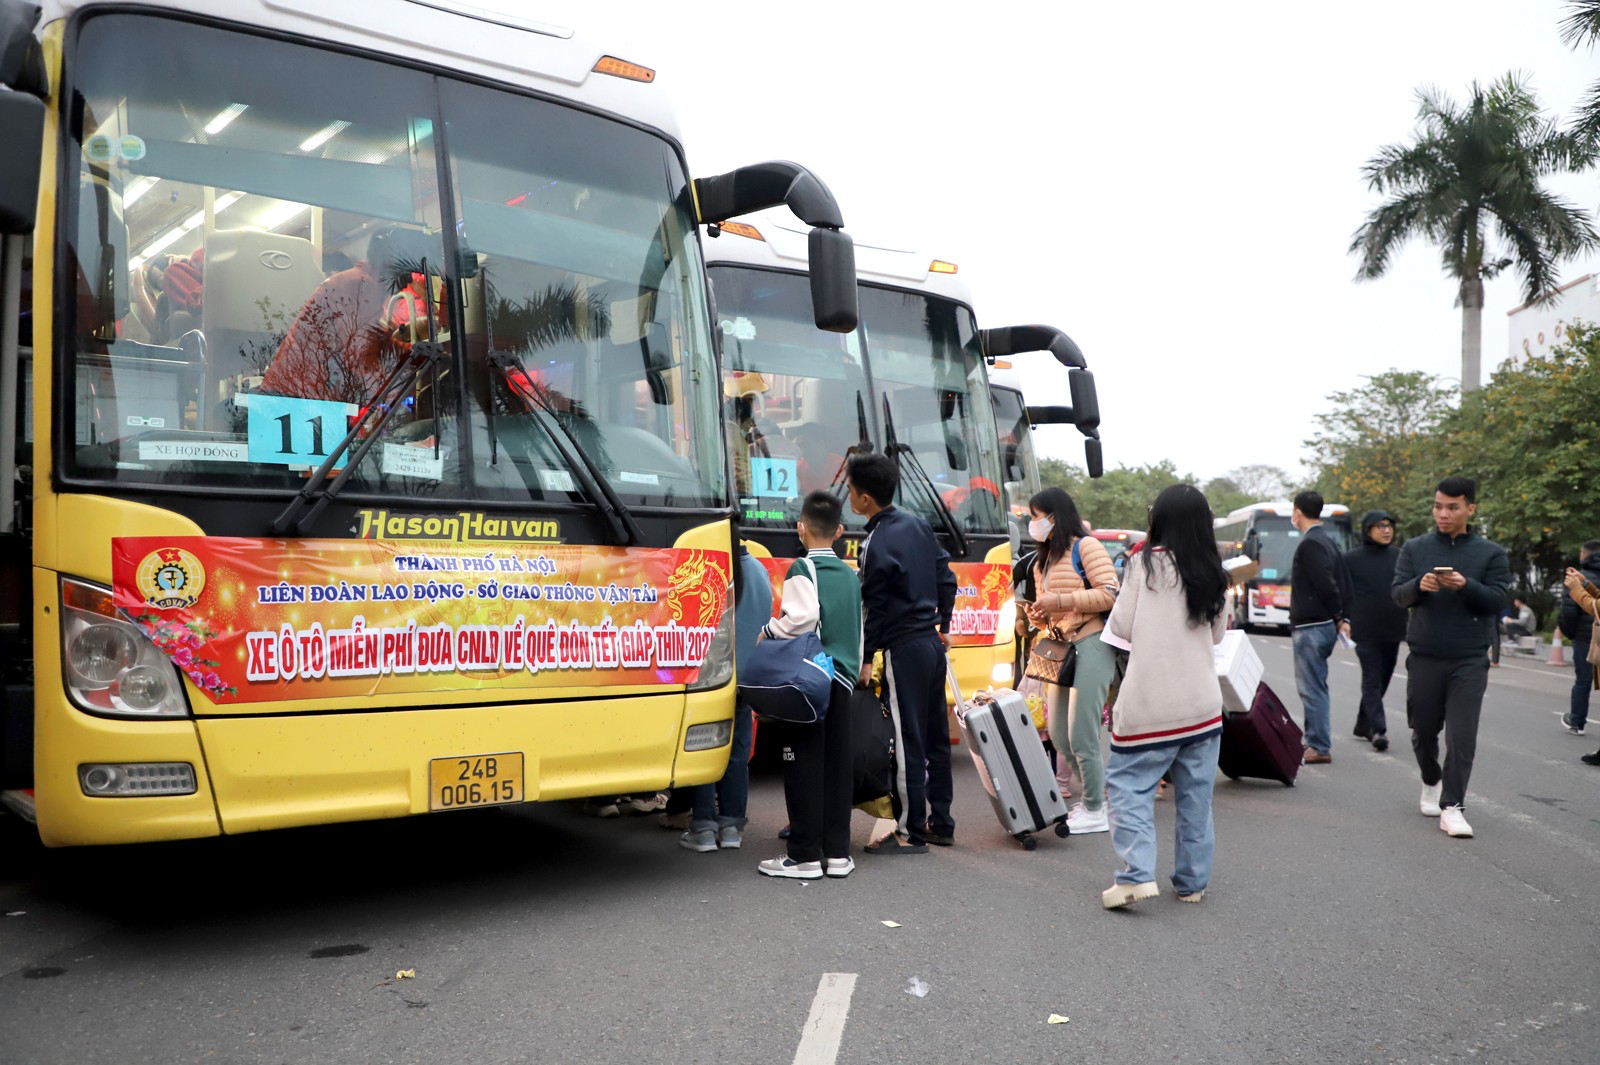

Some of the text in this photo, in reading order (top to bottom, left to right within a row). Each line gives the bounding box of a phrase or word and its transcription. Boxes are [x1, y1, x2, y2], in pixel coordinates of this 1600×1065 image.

[274, 413, 329, 456] 11
[155, 445, 172, 454] XE
[765, 467, 789, 492] 12
[395, 553, 557, 576] THÀNH PHỐ HÀ NỘI
[259, 582, 305, 602] LIÊN
[311, 581, 366, 601] ĐOÀN
[371, 585, 408, 600] LAO
[413, 580, 465, 602] ĐỘNG
[478, 579, 499, 599] SỞ
[502, 585, 541, 600] GIAO
[544, 583, 595, 601] THÔNG
[598, 585, 629, 605] VẬN
[632, 583, 657, 602] TẢI
[249, 636, 276, 675] XE
[281, 628, 295, 674] Ô
[300, 627, 323, 672] TÔ
[329, 621, 378, 671] MIỄN
[383, 625, 414, 668] PHÍ
[417, 627, 453, 666] ĐƯA
[504, 619, 523, 664] VỀ
[526, 624, 556, 667] QUÊ
[559, 624, 591, 663] ĐÓN
[592, 621, 617, 662] TẾT
[621, 625, 653, 662] GIÁP
[656, 624, 685, 661] THÌN
[458, 757, 497, 780] 24B
[441, 780, 514, 806] 006.15
